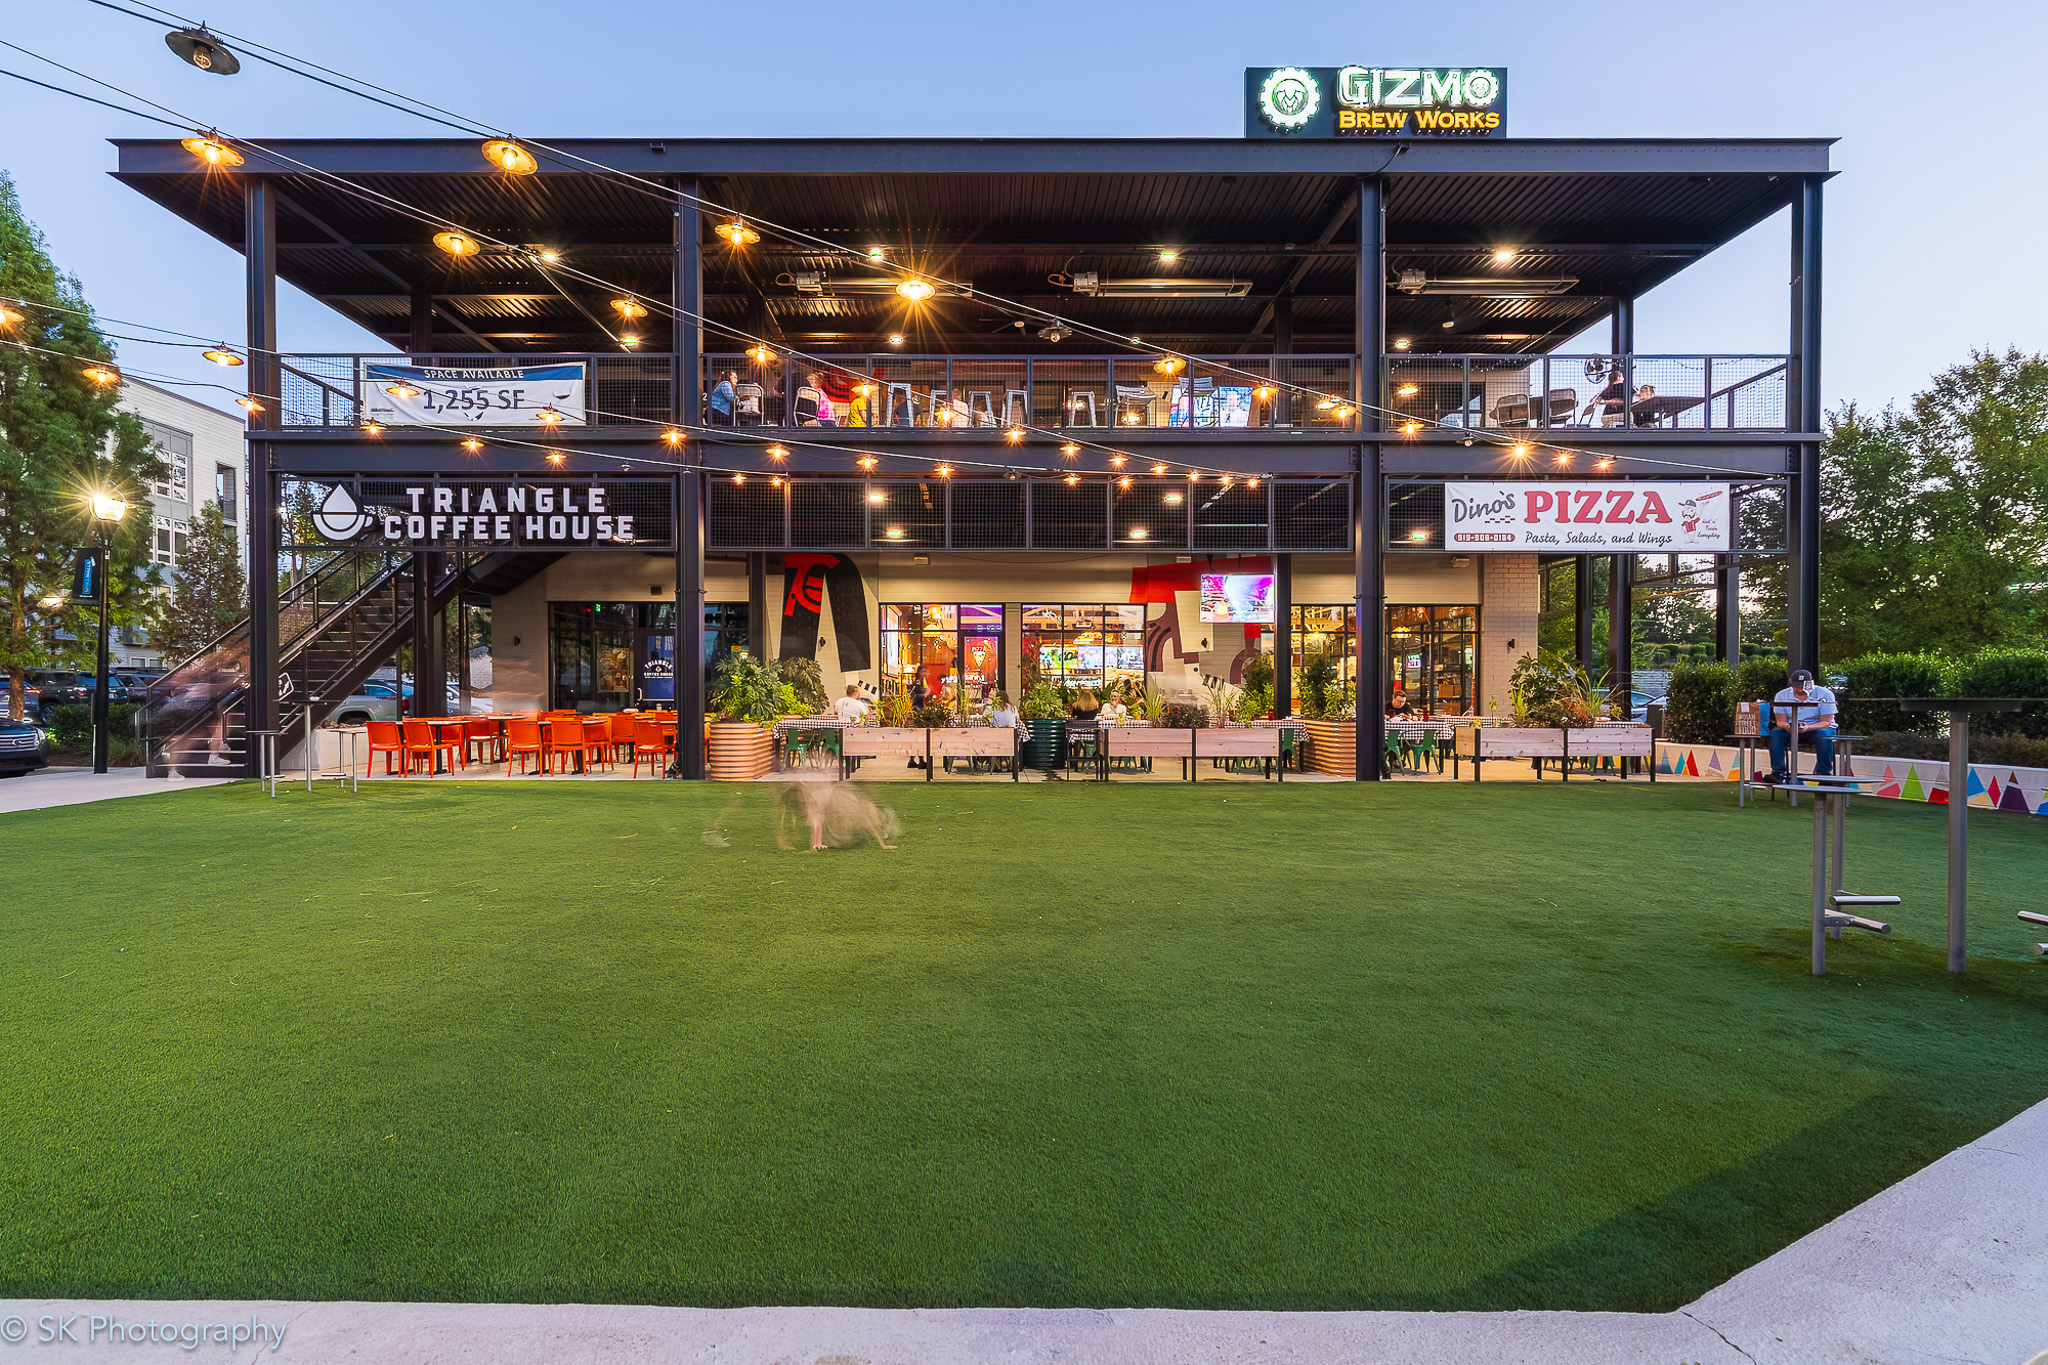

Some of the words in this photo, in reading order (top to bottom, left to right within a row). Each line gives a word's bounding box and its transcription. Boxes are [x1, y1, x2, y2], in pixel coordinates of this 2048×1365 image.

[1337, 65, 1500, 110] GIZMO
[424, 369, 458, 379] SPACE
[462, 370, 525, 379] AVAILABLE
[423, 389, 489, 414] 1,255
[498, 389, 525, 410] SF
[406, 487, 605, 513] TRIANGLE
[1451, 490, 1516, 523] Dino's
[1523, 490, 1673, 524] PIZZA
[384, 515, 511, 540] COFFEE
[526, 515, 634, 540] HOUSE
[1525, 531, 1561, 545] Pasta,
[1565, 531, 1607, 544] Salads,
[1611, 531, 1635, 544] and
[1638, 531, 1673, 547] Wings
